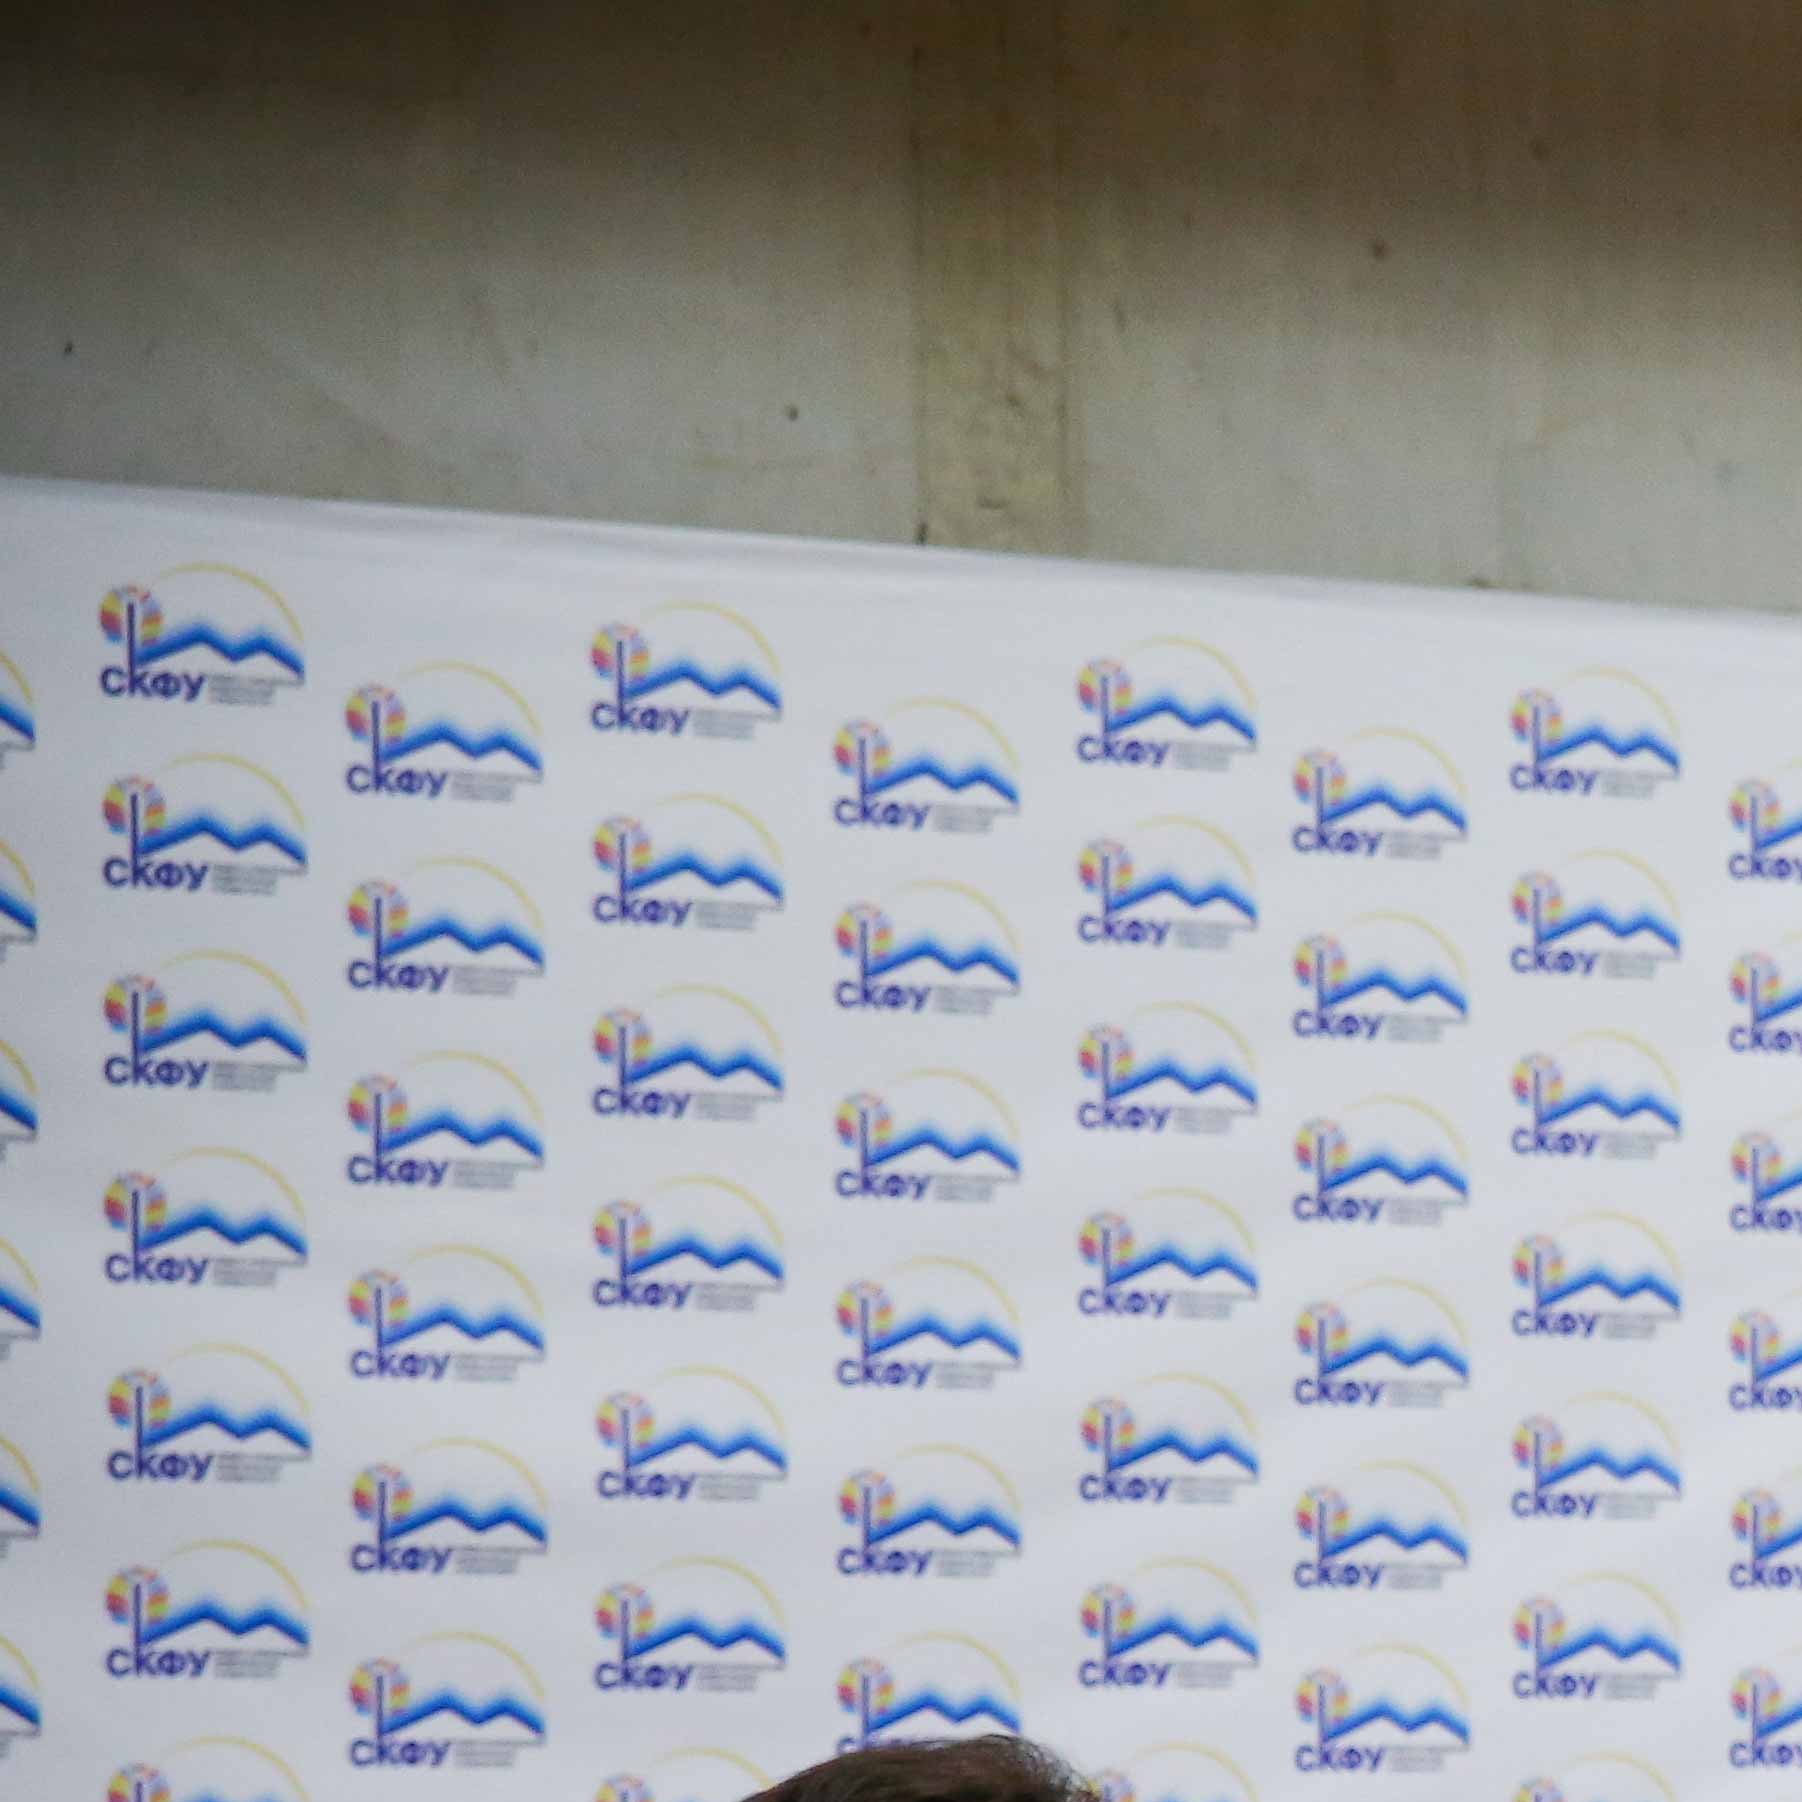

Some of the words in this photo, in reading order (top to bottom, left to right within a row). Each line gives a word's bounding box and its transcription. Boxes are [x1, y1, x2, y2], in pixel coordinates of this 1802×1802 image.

[100, 665, 205, 699] СКФУ
[590, 701, 687, 733] СКФУ
[1076, 735, 1167, 765] СКФУ
[345, 762, 445, 795] СКФУ
[834, 797, 927, 828] СКФУ
[103, 857, 207, 891] СКФУ
[592, 893, 689, 925] СКФУ
[1078, 914, 1169, 943] СКФУ
[347, 959, 447, 991] СКФУ
[835, 979, 928, 1010] СКФУ
[104, 1052, 208, 1085] СКФУ
[594, 1086, 691, 1117] СКФУ
[1077, 1101, 1168, 1130] СКФУ
[347, 1153, 447, 1185] СКФУ
[835, 1168, 928, 1198] СКФУ
[104, 1251, 208, 1284] СКФУ
[593, 1279, 689, 1309] СКФУ
[1078, 1287, 1169, 1315] СКФУ
[348, 1349, 448, 1381] СКФУ
[836, 1359, 929, 1388] СКФУ
[108, 1449, 212, 1481] СКФУ
[597, 1471, 693, 1500] СКФУ
[1080, 1475, 1171, 1503] СКФУ
[350, 1542, 450, 1573] СКФУ
[838, 1548, 931, 1576] СКФУ
[106, 1647, 210, 1678] СКФУ
[594, 1663, 690, 1692] СКФУ
[1080, 1660, 1171, 1687] СКФУ
[348, 1738, 448, 1768] СКФУ
